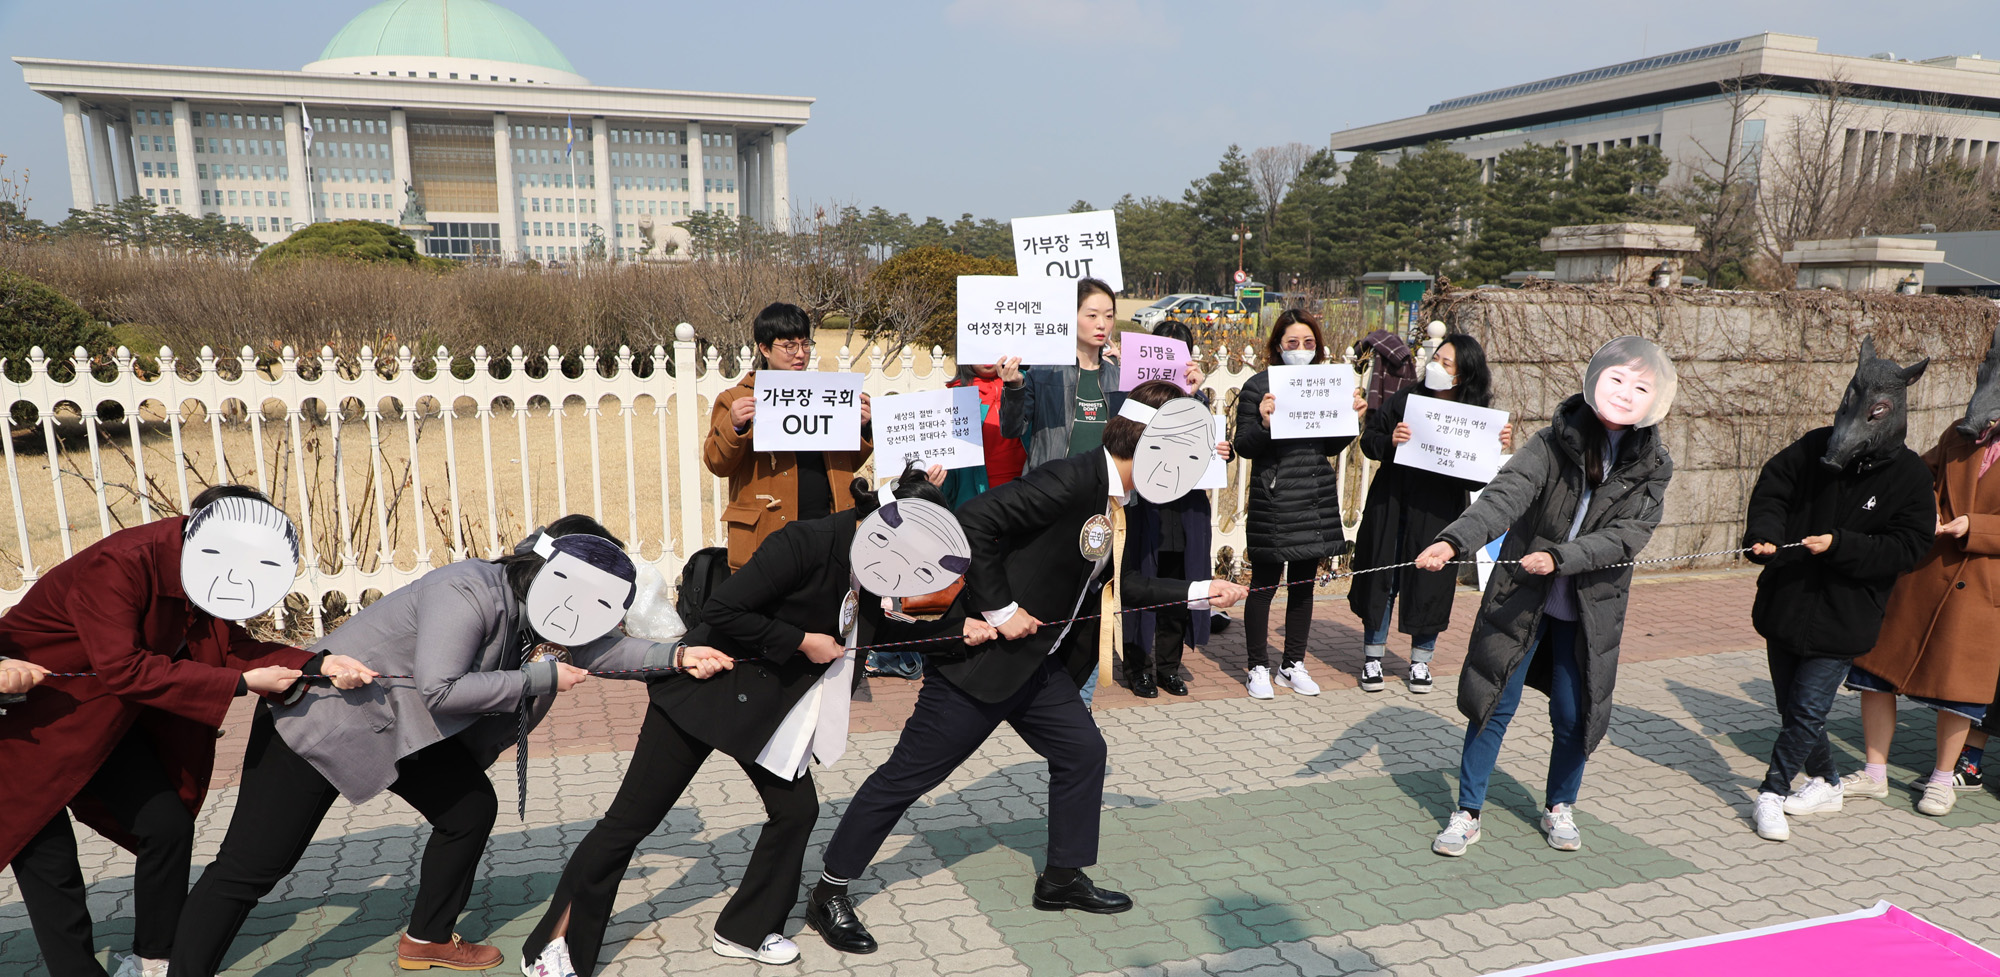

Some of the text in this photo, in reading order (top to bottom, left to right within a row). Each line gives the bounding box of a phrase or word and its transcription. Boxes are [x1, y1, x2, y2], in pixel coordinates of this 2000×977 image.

[1022, 231, 1111, 255] 가부장 국회
[1045, 258, 1094, 279] OUT
[994, 301, 1042, 314] 우리에겐
[967, 322, 1069, 336] 여성정치가 필요해
[1140, 346, 1176, 360] 51명을
[1137, 367, 1177, 381] 51%로!
[1289, 378, 1342, 387] 국회 법사위 여성
[763, 388, 854, 407] 가부장 국회
[1301, 389, 1330, 397] 2명/18명
[894, 411, 915, 421] 세상의
[919, 409, 933, 418] 절반
[945, 406, 959, 415] 여성
[1289, 410, 1338, 419] 미투법안 통과율
[1425, 411, 1487, 430] 국회 법사위 여성
[782, 414, 833, 435] OUT
[886, 423, 915, 434] 후보자의
[918, 420, 946, 430] 절대다수
[1436, 425, 1470, 438] 2명/18명
[886, 434, 915, 445] 당선자의
[920, 431, 947, 441] 절대다수
[925, 447, 955, 458] 민주주의
[1420, 443, 1477, 462] 미투법안 통과율
[1437, 458, 1455, 468] 24%
[1089, 531, 1105, 543] 국회
